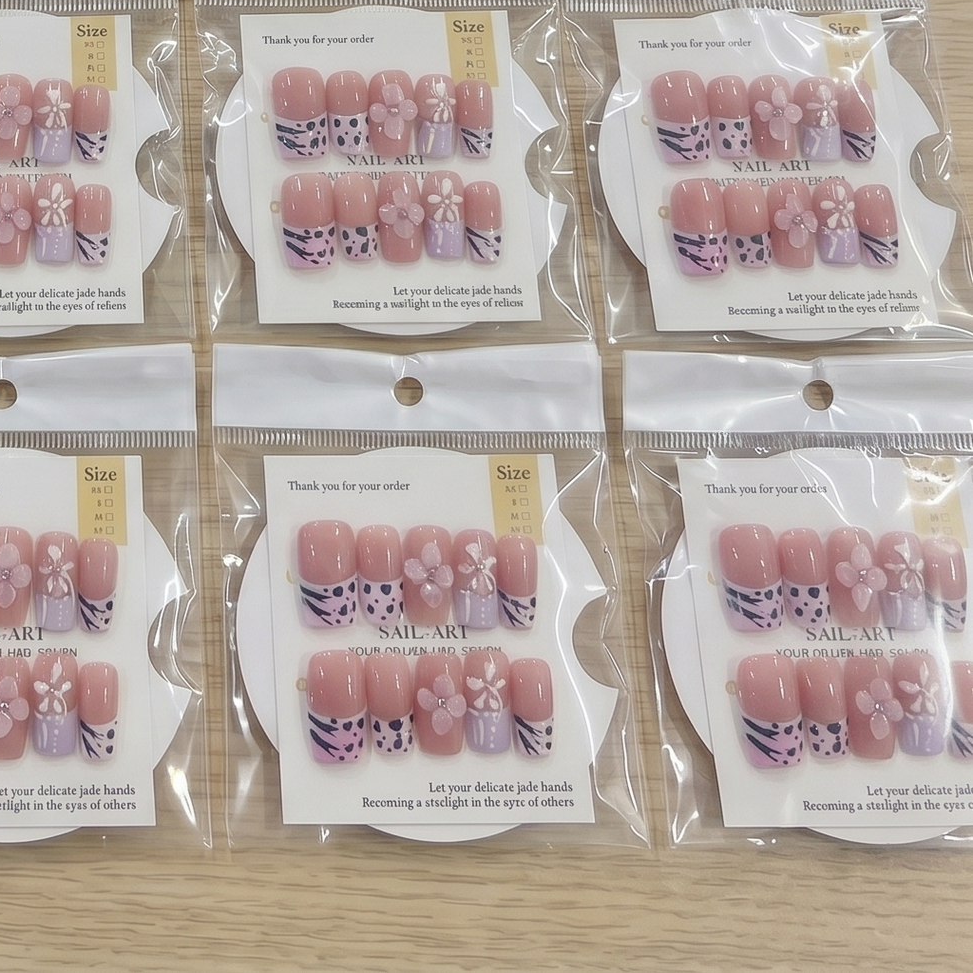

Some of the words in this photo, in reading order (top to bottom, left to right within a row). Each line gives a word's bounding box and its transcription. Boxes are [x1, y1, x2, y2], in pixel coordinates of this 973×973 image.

[76, 24, 108, 38] Size
[453, 19, 485, 34] Size
[261, 35, 292, 45] Thank
[293, 37, 311, 47] you
[312, 34, 326, 45] for
[327, 37, 349, 47] your
[350, 33, 375, 44] order
[15, 291, 38, 302] your
[38, 288, 75, 299] delicate
[75, 287, 96, 301] jade
[97, 287, 127, 298] hands
[392, 286, 409, 296] Let
[409, 288, 433, 298] your
[433, 285, 471, 296] delicate
[471, 284, 492, 298] jade
[492, 284, 523, 295] hands
[84, 466, 117, 482] Size
[497, 464, 531, 481] Size
[287, 480, 321, 491] Thank
[321, 483, 341, 495] you
[342, 480, 357, 491] for
[358, 483, 382, 495] your
[382, 480, 411, 491] order
[10, 788, 35, 800] your
[37, 784, 77, 796] delicate
[78, 783, 101, 799] jade
[103, 783, 136, 796] hands
[428, 782, 447, 793] Let
[447, 784, 472, 796] your
[474, 781, 515, 793] delicate
[516, 780, 539, 796] jade
[540, 780, 574, 793] hands
[866, 785, 884, 797] Let
[912, 784, 953, 796] delicate
[33, 799, 44, 811] in
[45, 798, 63, 811] the
[89, 798, 102, 811] of
[415, 799, 423, 808] a
[471, 796, 482, 808] in
[483, 795, 501, 808] the
[527, 795, 540, 808] of
[540, 795, 575, 808] others
